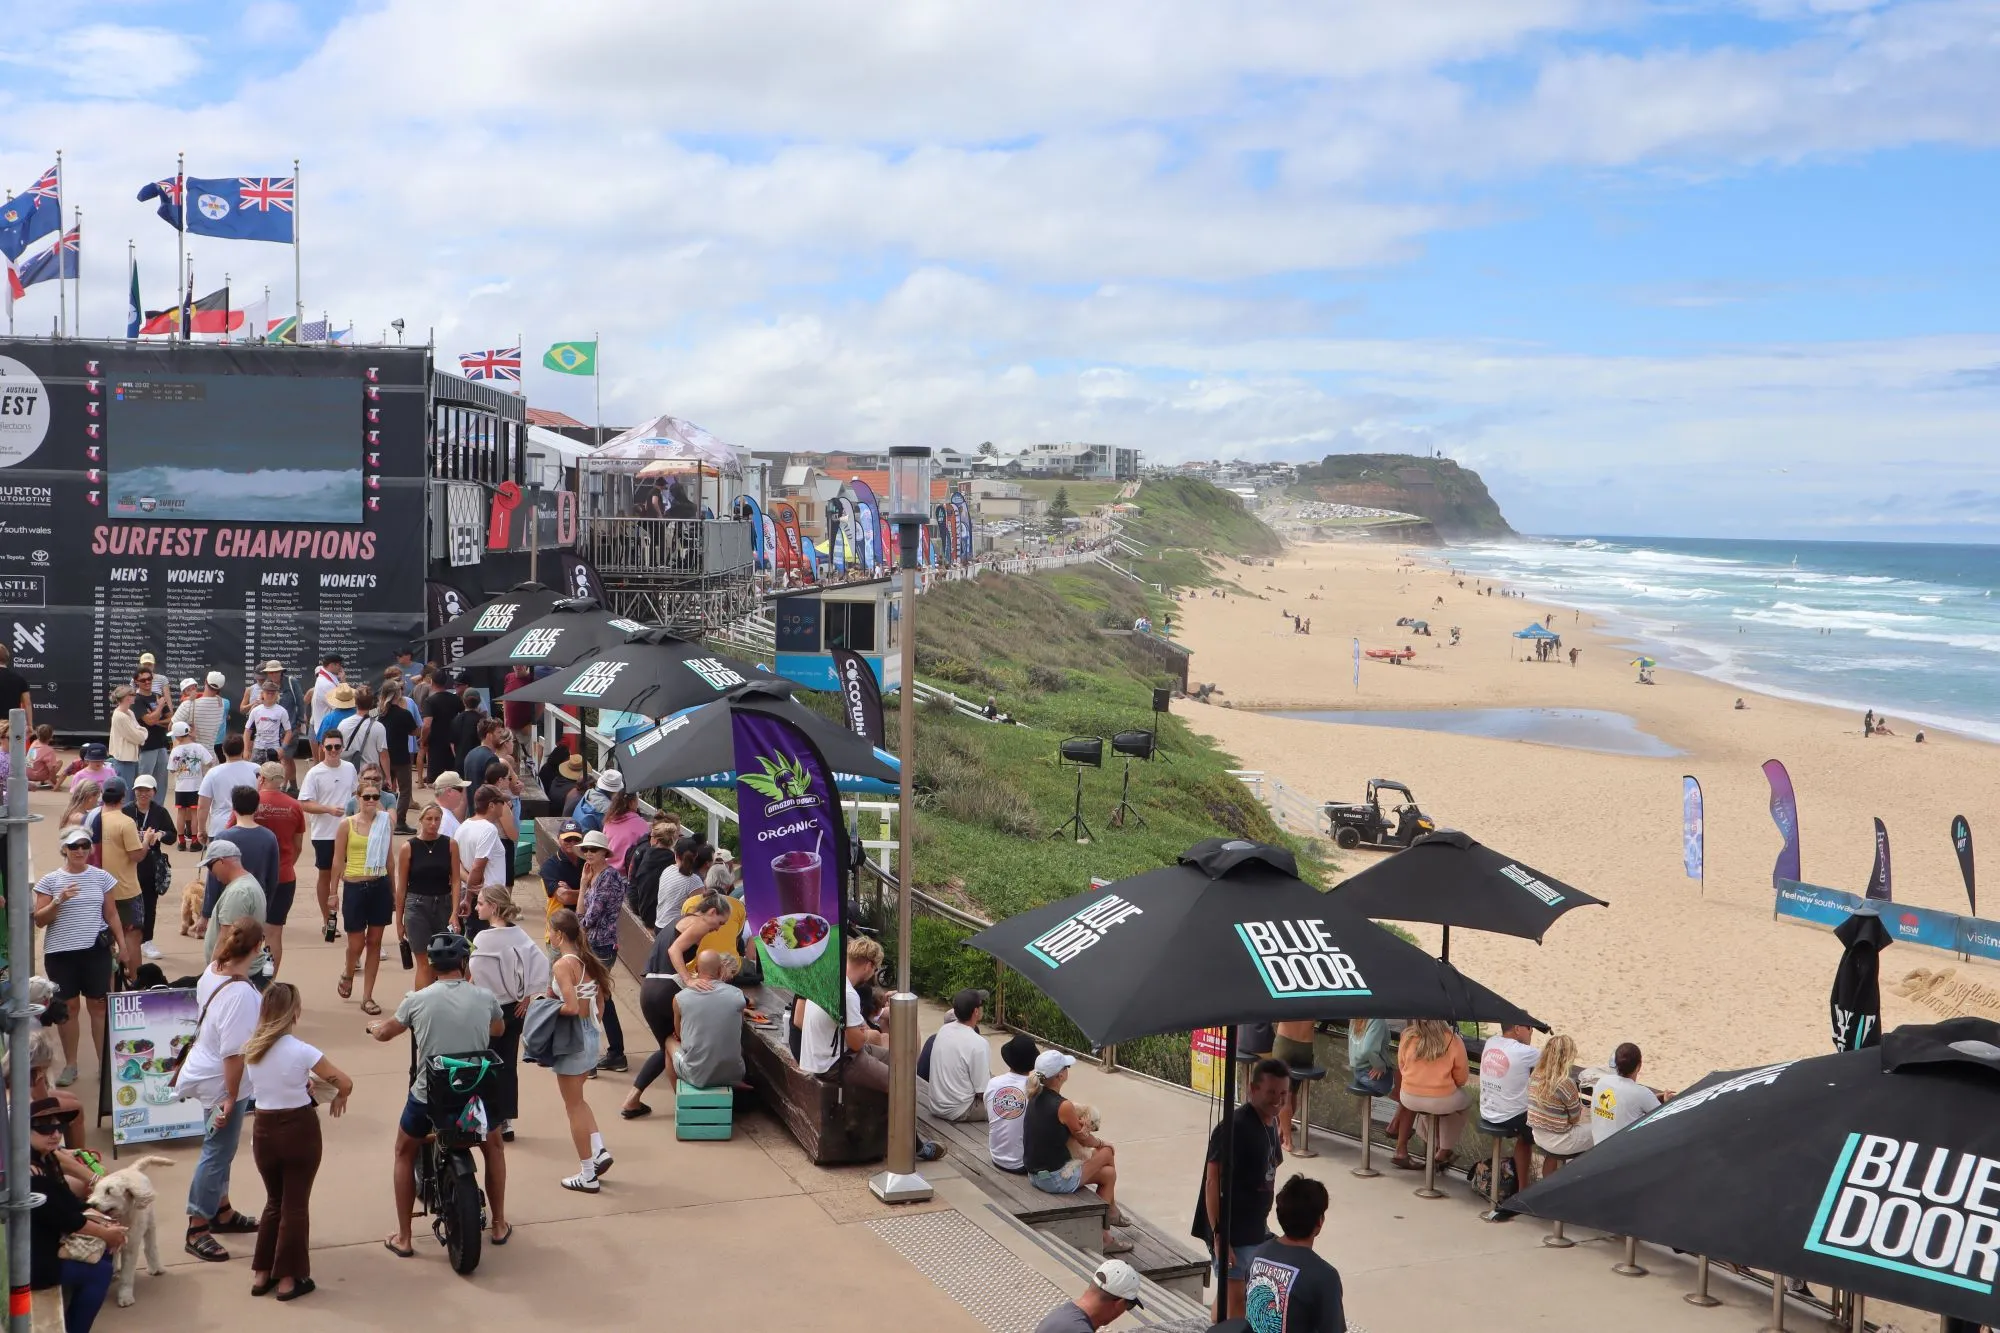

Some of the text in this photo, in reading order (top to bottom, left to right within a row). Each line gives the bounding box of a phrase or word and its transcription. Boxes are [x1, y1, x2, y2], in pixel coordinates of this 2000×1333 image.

[1, 396, 37, 416] EST
[92, 525, 378, 561] SURFEST CHAMPIONS
[110, 568, 148, 582] MEN'S
[167, 569, 225, 584] WOMEN'S
[261, 572, 299, 586] MEN'S
[320, 574, 377, 588] WOMEN'S
[487, 604, 520, 616] BLUE
[478, 616, 514, 629] DOOR
[526, 628, 564, 642] BLUE
[516, 641, 556, 656] DOOR
[588, 662, 629, 677] BLUE
[686, 658, 730, 672] BLUE
[570, 676, 616, 694] DOOR
[704, 670, 748, 688] DOOR
[768, 799, 795, 813] amazon
[758, 818, 818, 841] ORGANIC
[1957, 838, 1966, 848] HIT
[1782, 890, 1797, 900] feel
[1797, 894, 1814, 904] new
[1814, 898, 1836, 909] south
[1077, 894, 1144, 934] BLUE
[1243, 919, 1340, 955] BLUE
[1900, 924, 1919, 934] NSW
[1034, 920, 1100, 964] DOOR
[1262, 952, 1368, 992] DOOR
[115, 996, 142, 1012] BLUE
[115, 1012, 145, 1028] DOOR
[1846, 1134, 2000, 1216] BLUE
[1826, 1186, 2000, 1282] DOOR
